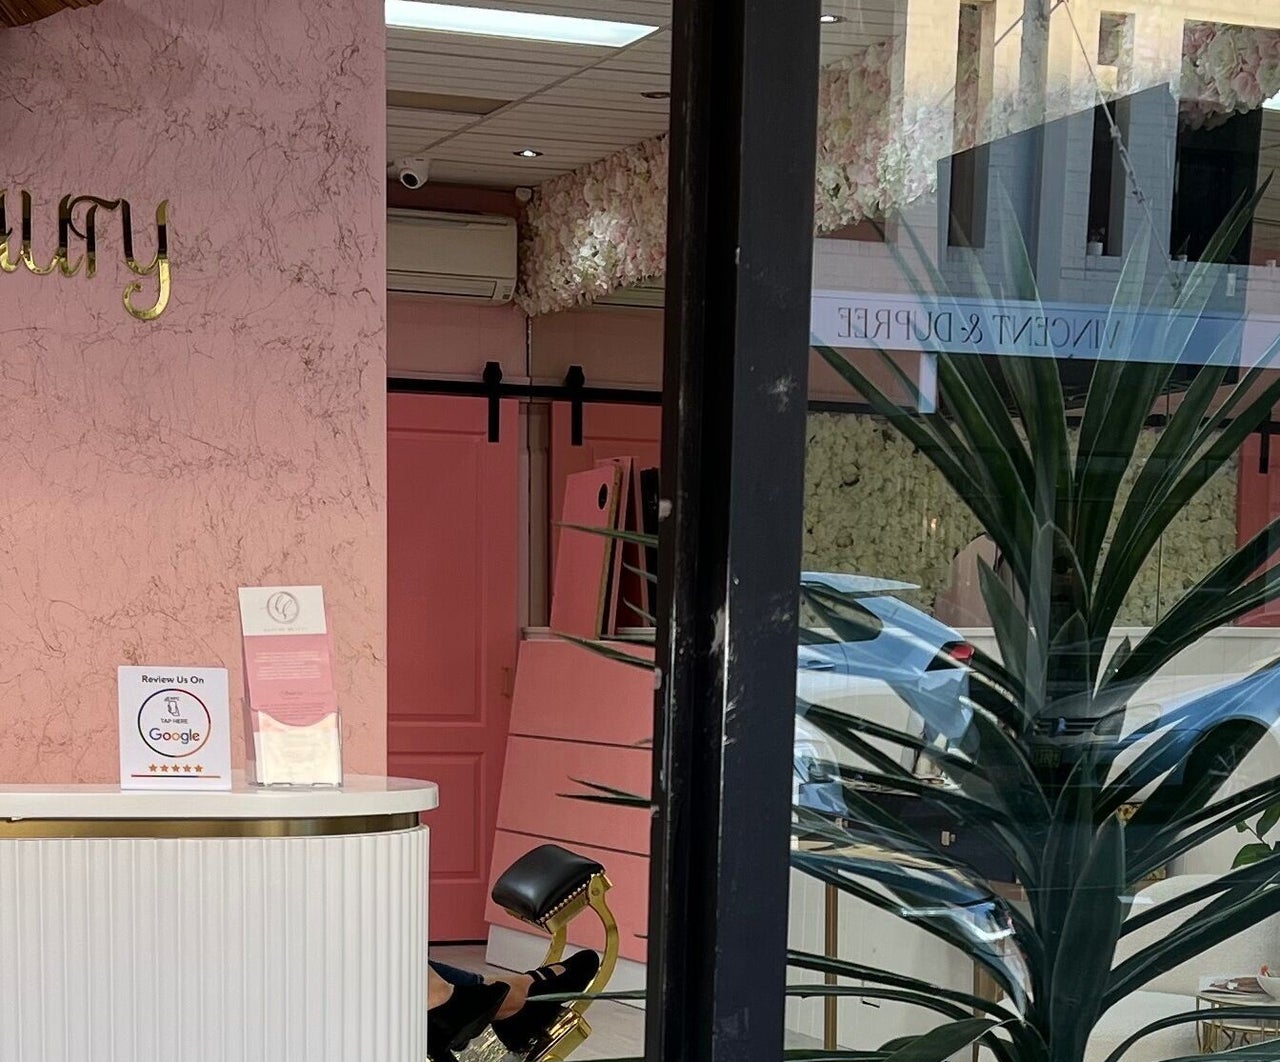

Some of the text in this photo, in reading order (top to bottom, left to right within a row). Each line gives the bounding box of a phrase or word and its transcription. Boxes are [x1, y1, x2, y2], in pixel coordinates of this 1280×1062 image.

[141, 674, 204, 684] Review Us On
[149, 728, 200, 745] Google
